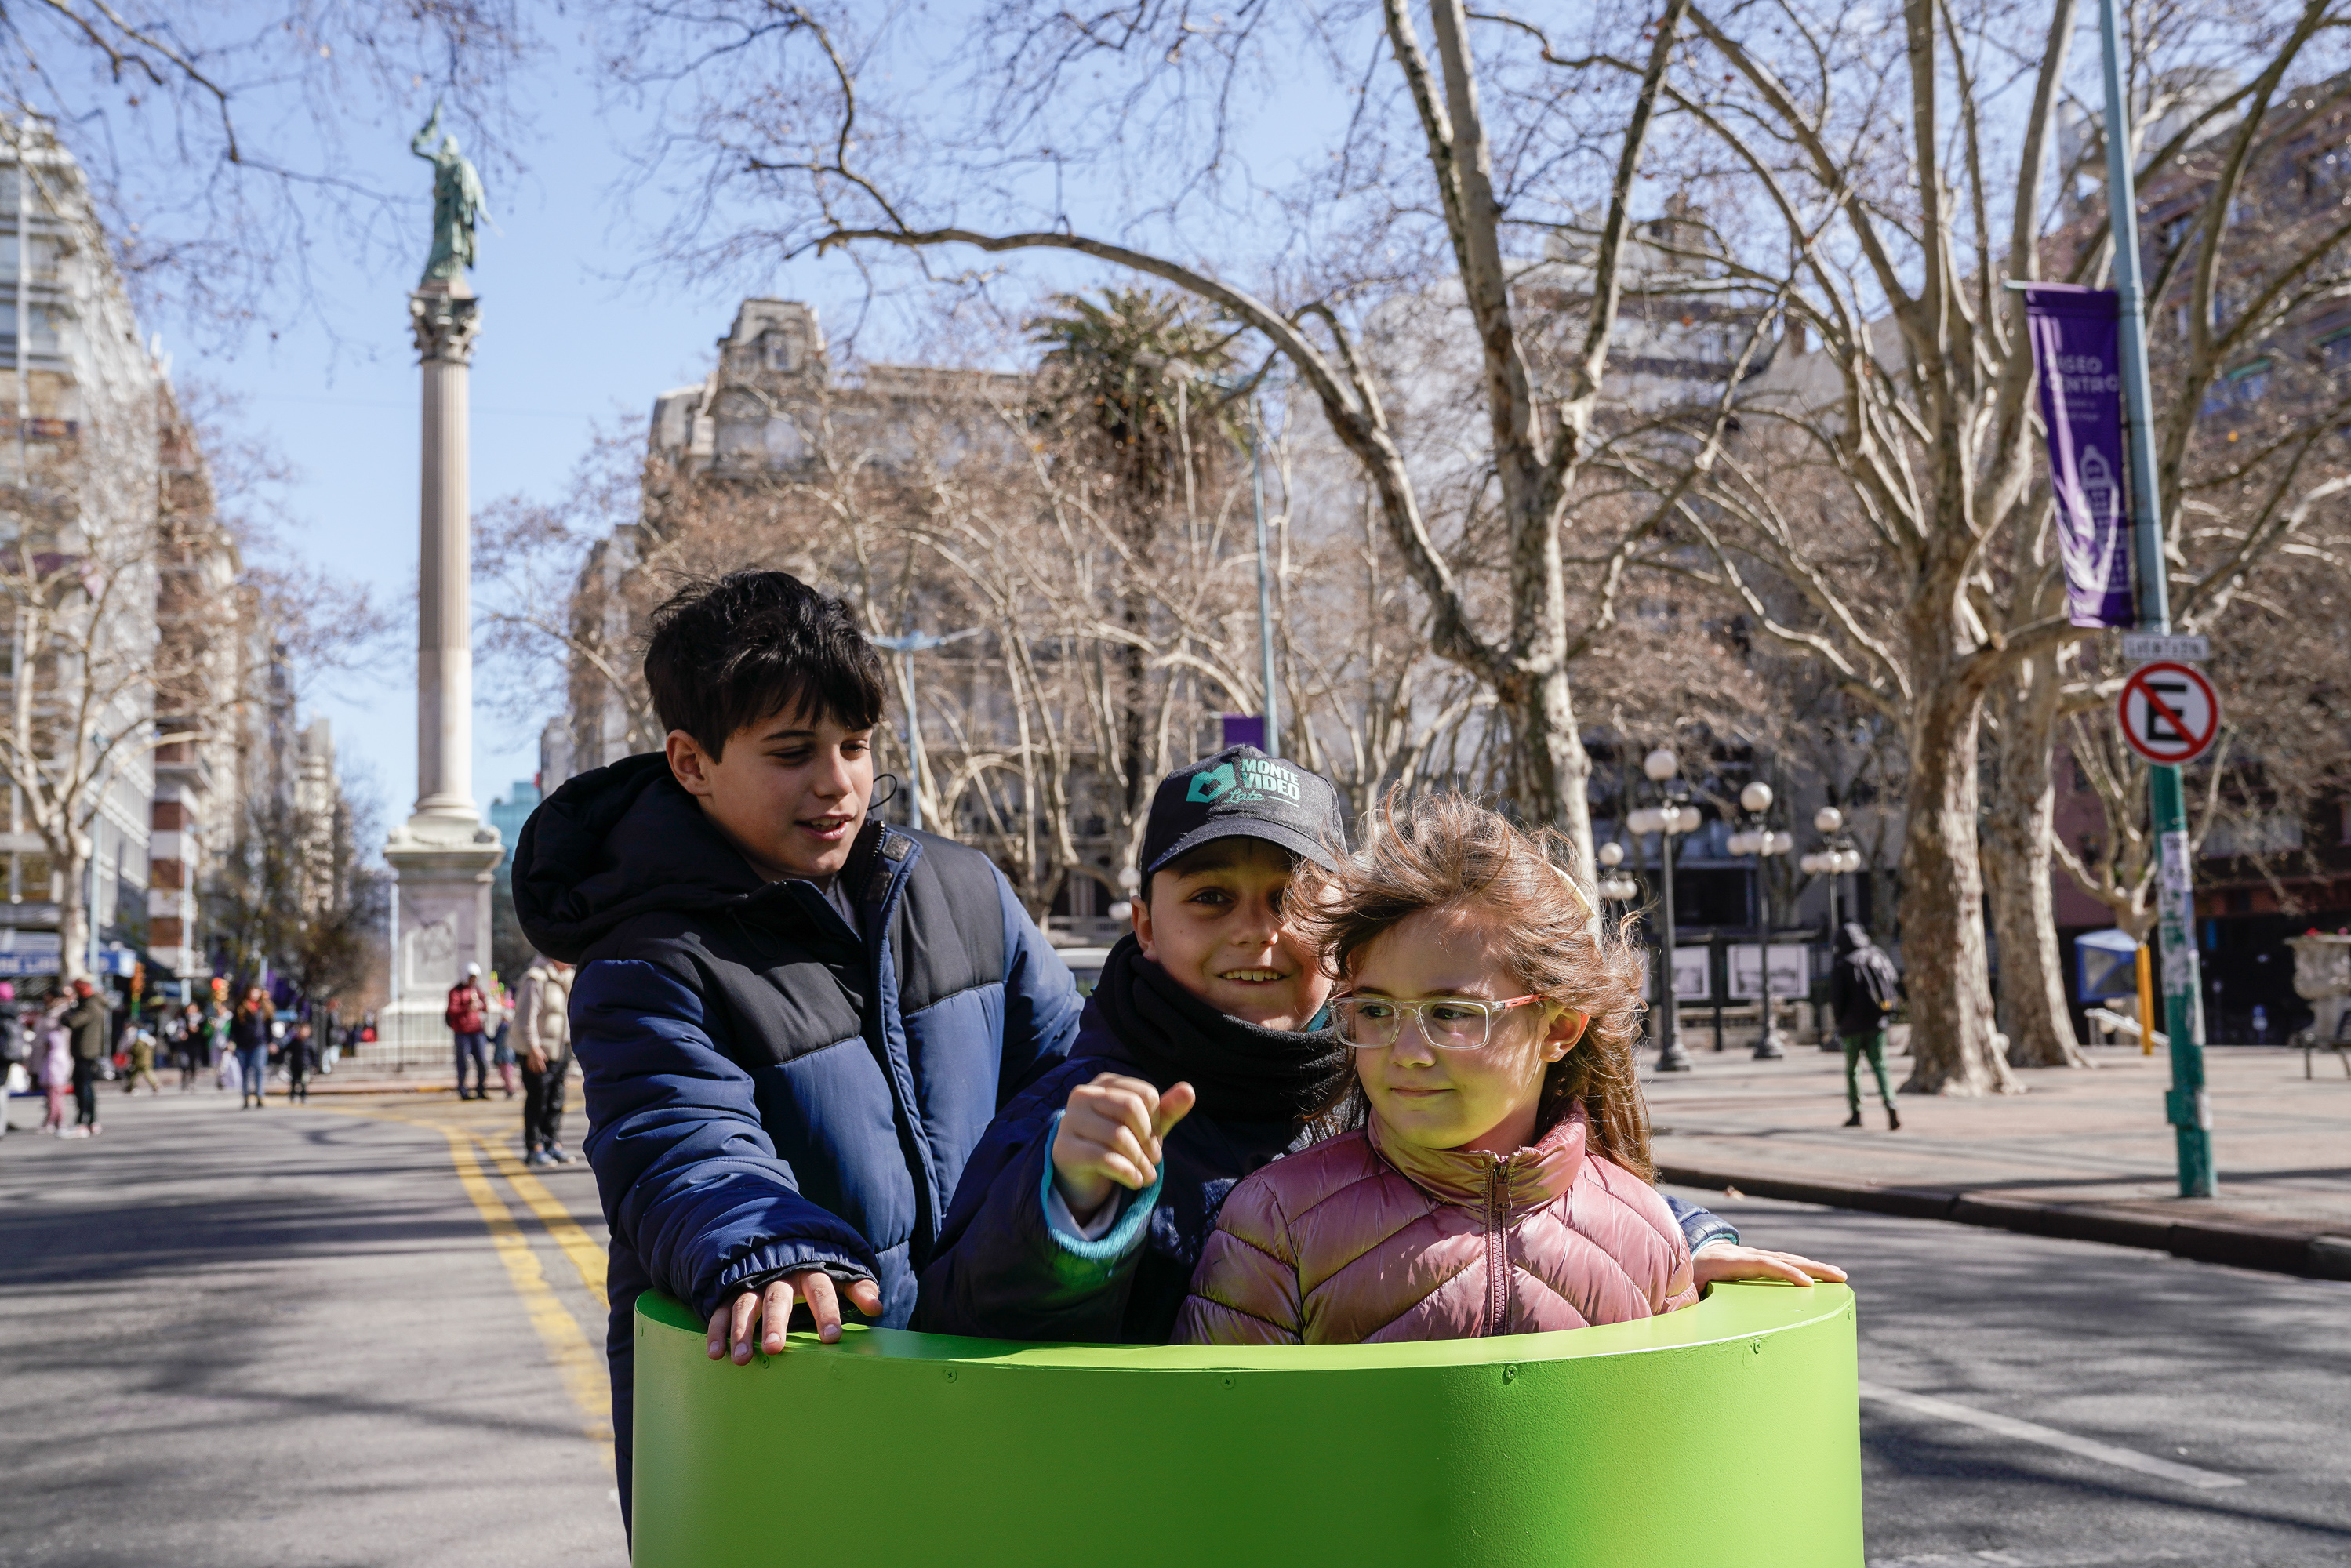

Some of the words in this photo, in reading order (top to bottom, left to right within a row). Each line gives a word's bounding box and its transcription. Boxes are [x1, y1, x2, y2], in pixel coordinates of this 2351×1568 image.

[2147, 683, 2187, 740] E
[1241, 758, 1299, 786] MONTE
[1241, 771, 1299, 800] VIDEO
[1224, 788, 1264, 804] Late
